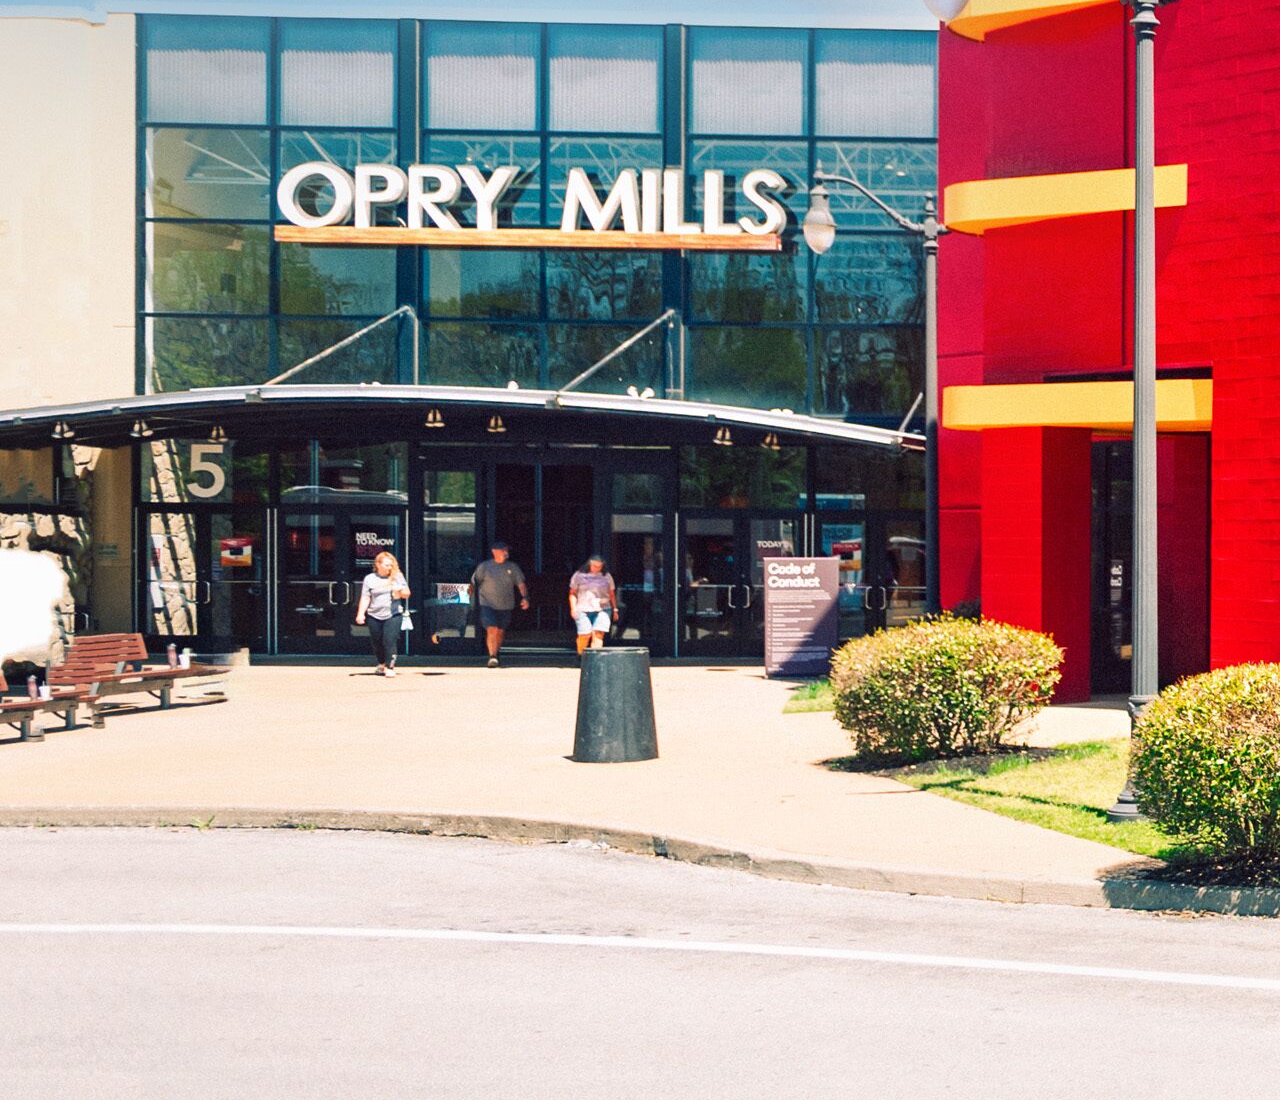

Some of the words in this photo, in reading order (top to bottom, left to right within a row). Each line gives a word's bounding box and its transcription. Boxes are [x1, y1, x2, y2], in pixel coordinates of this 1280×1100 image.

[276, 161, 520, 231] OPRY
[561, 167, 788, 234] MILLS
[186, 444, 226, 499] 5
[355, 532, 378, 541] NEED
[767, 562, 801, 576] Code
[802, 562, 816, 575] of
[767, 576, 820, 588] Conduct
